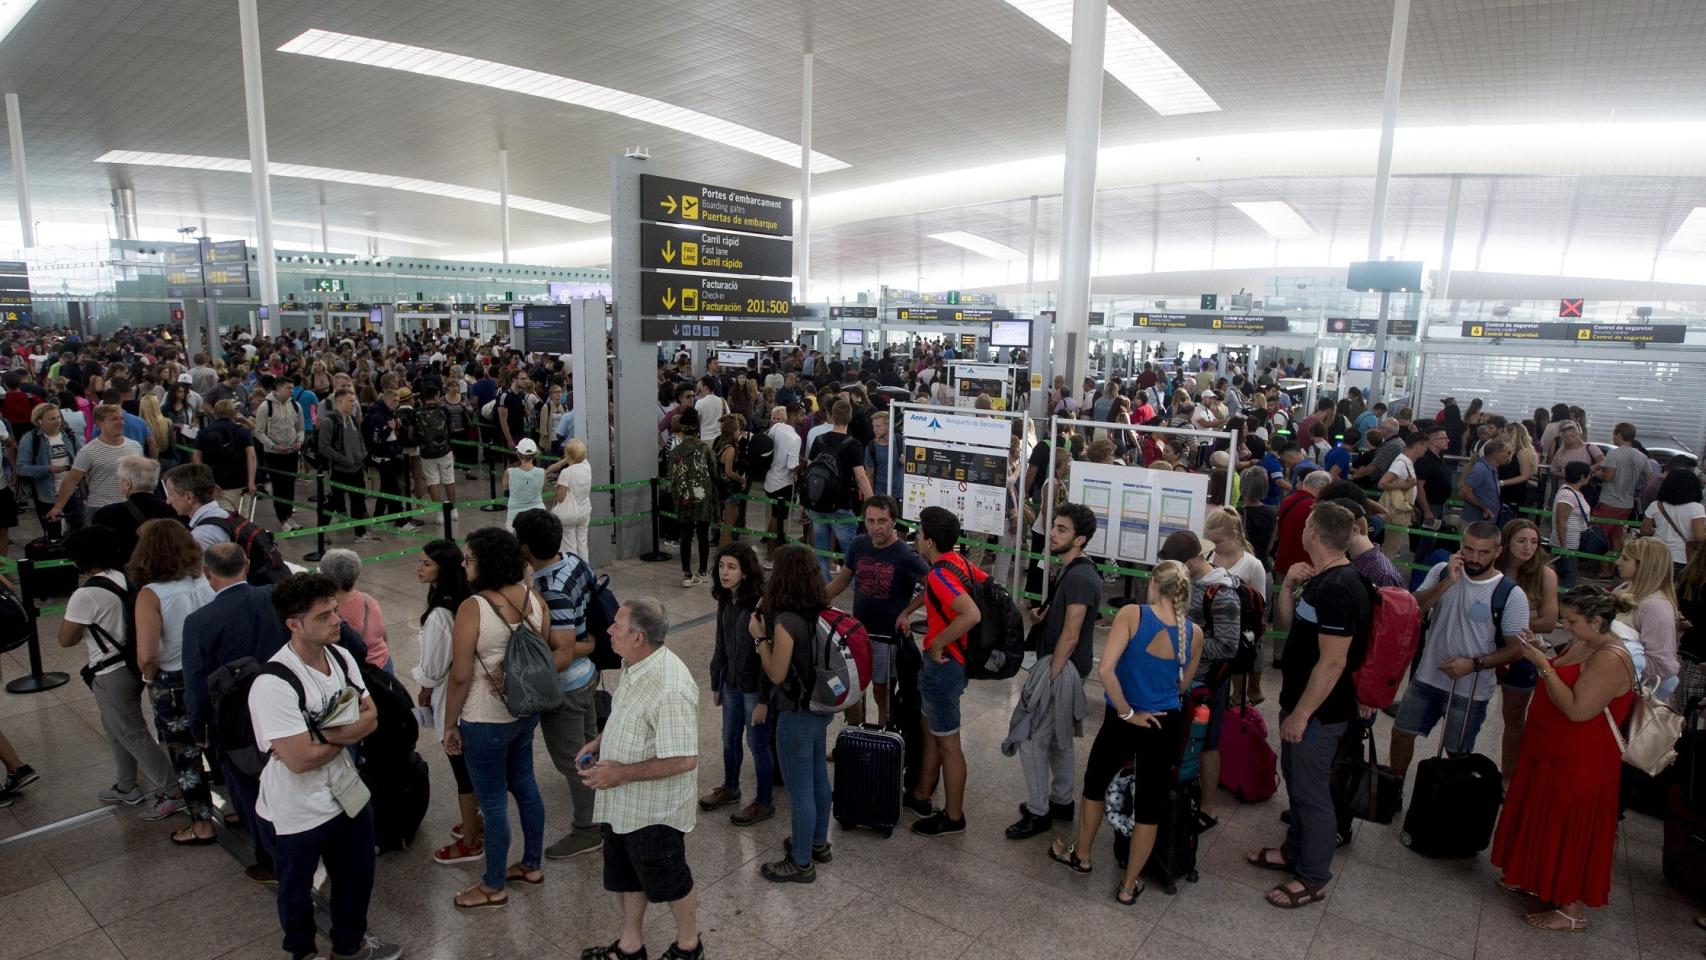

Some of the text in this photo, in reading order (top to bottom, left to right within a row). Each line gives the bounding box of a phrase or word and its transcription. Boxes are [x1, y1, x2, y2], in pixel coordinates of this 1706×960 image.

[702, 187, 782, 209] Portes d'embarcament
[702, 199, 745, 214] Boarding gates
[702, 211, 778, 230] Puertas de embarque
[702, 234, 740, 247] Carril ràpid
[702, 245, 728, 256] Fast lane
[702, 256, 743, 270] Carril rápido
[702, 279, 738, 290] Facturació
[702, 290, 724, 300] Check-in
[702, 301, 742, 312] Facturación
[910, 413, 927, 422] Aena
